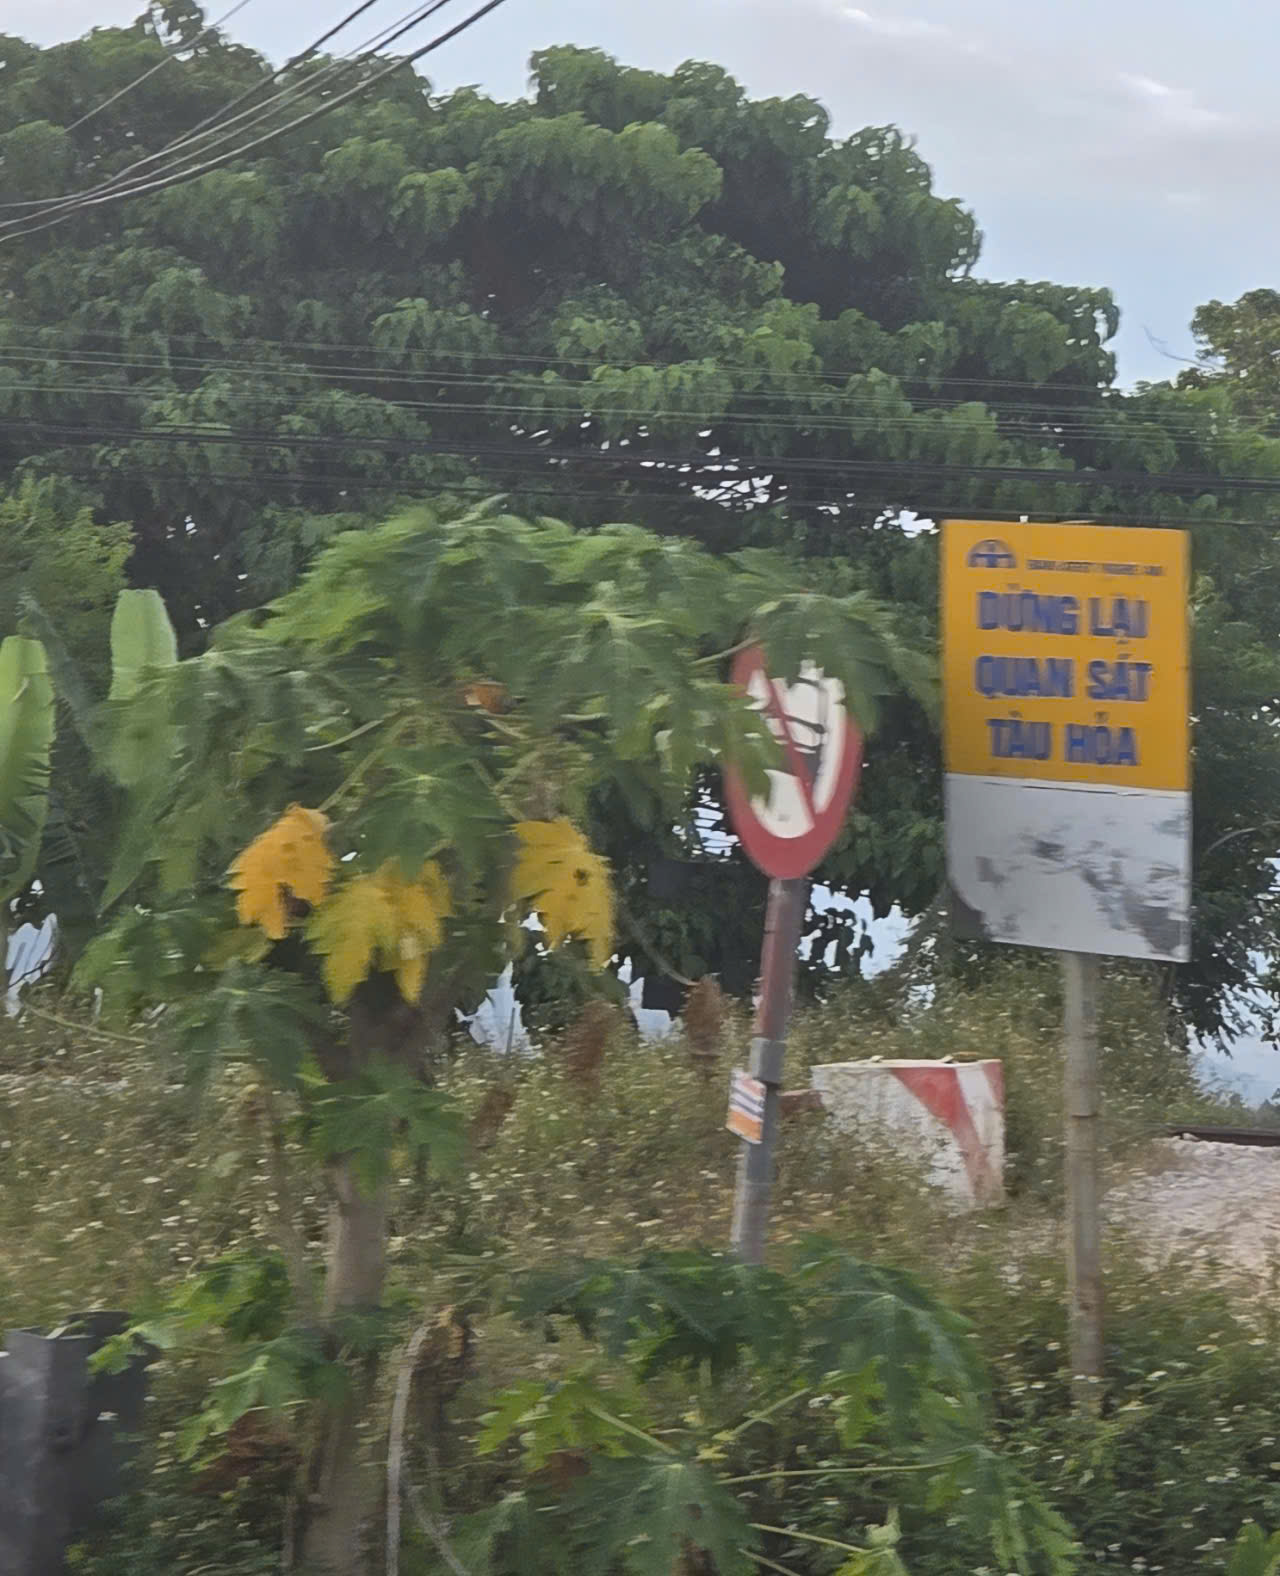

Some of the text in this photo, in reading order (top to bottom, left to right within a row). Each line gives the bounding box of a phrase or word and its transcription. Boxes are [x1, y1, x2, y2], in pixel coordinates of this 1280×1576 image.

[976, 583, 1148, 645] DỪNG LẠI
[974, 653, 1153, 701] QUAN SÁT
[986, 710, 1139, 766] TÀU HỎA
